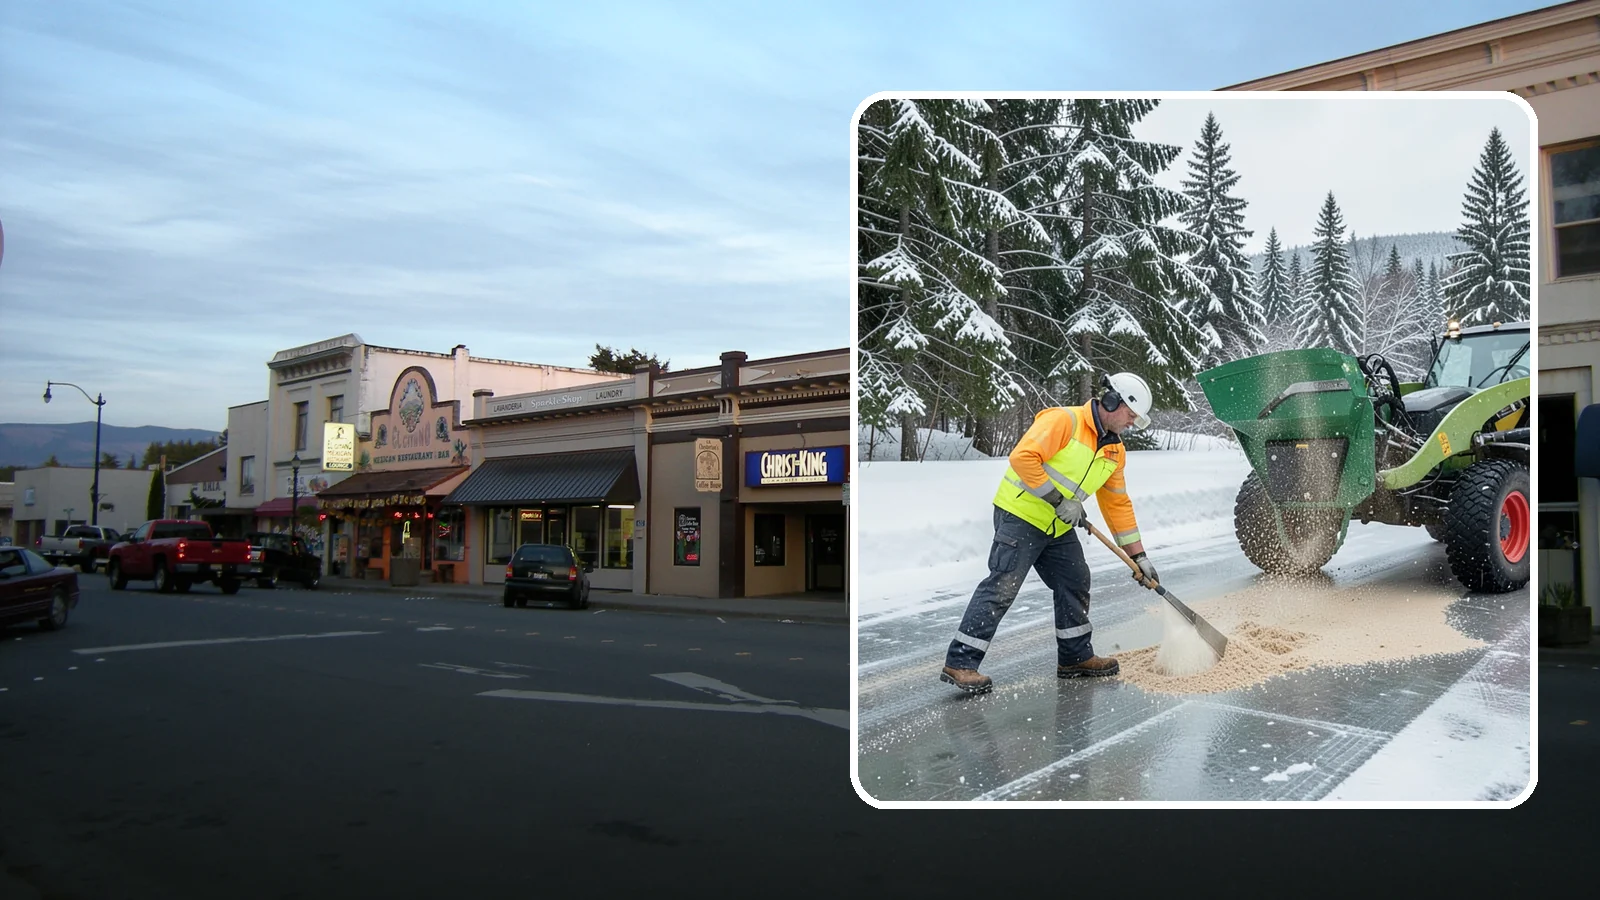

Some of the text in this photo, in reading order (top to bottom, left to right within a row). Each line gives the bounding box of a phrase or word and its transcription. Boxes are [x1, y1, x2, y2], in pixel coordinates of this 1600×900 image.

[493, 402, 523, 413] LAVANDERIA
[562, 394, 582, 405] Shop
[595, 389, 623, 400] LAUNDRY
[373, 455, 396, 464] MEXICAN
[397, 452, 433, 462] RESTAURANT
[437, 450, 450, 459] BAR
[760, 450, 827, 478] CHRIST KING
